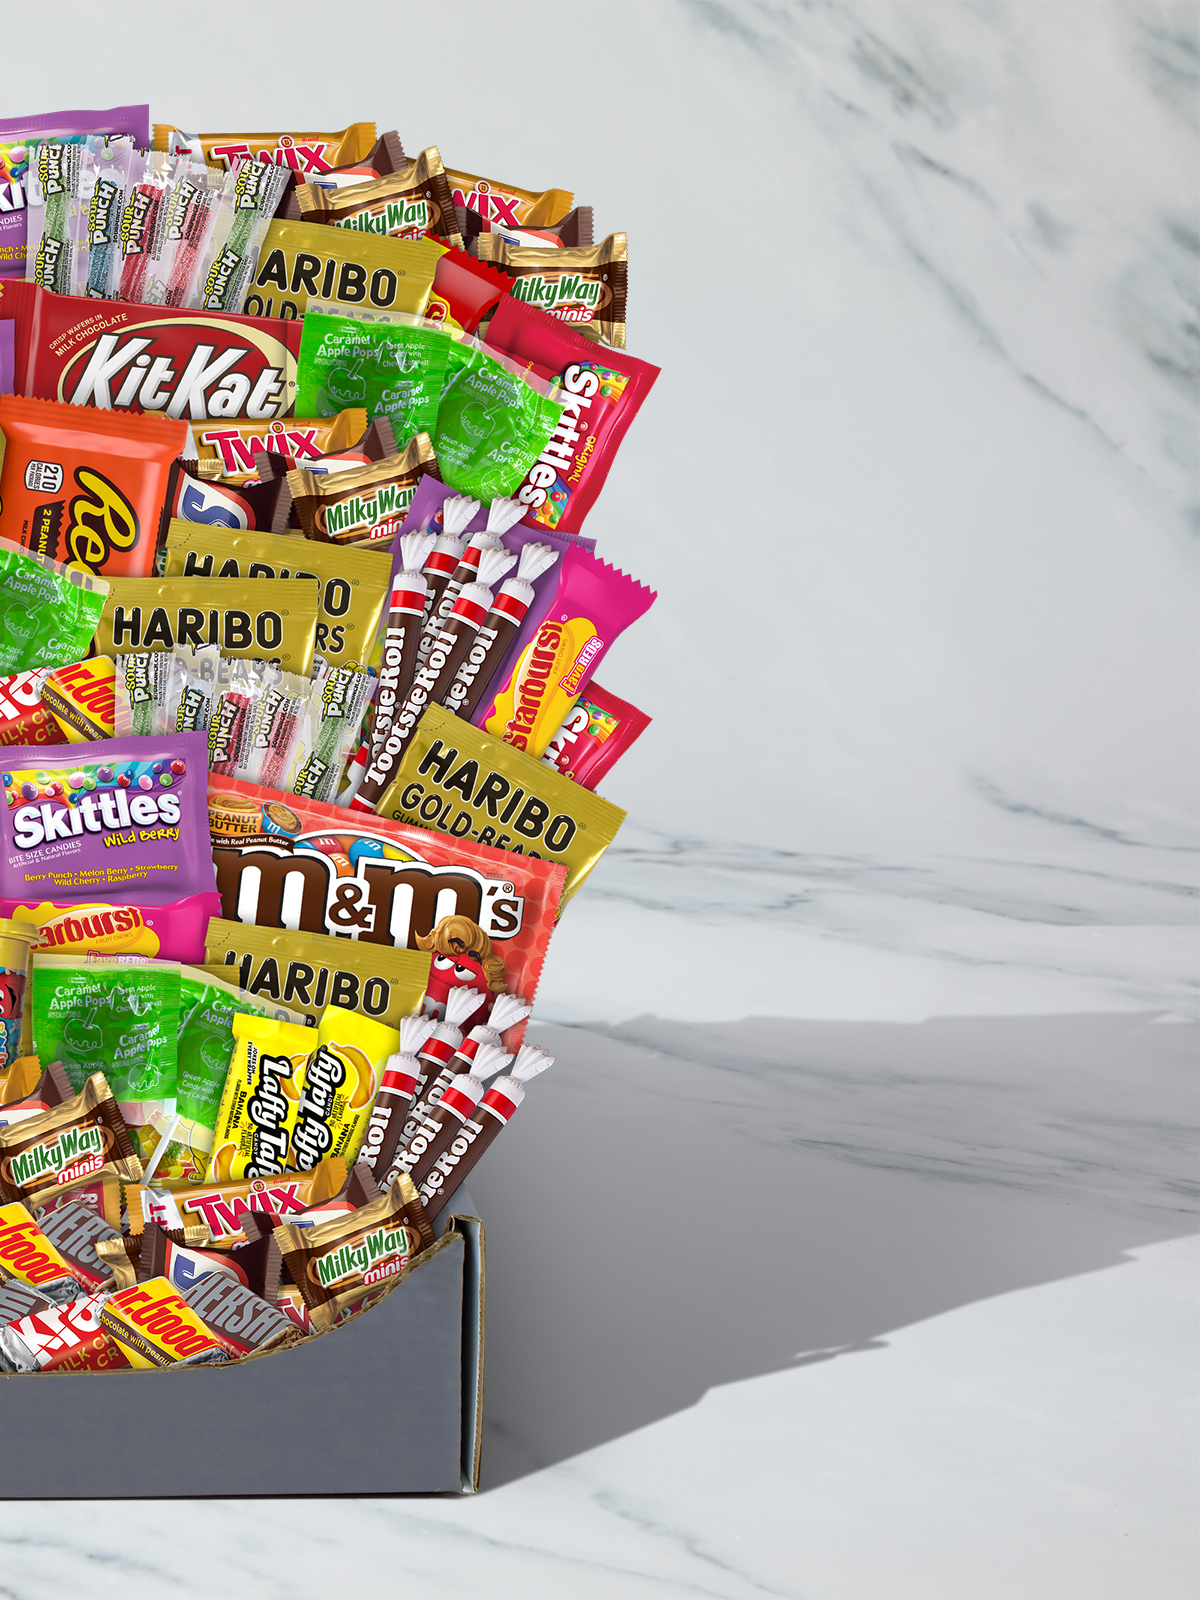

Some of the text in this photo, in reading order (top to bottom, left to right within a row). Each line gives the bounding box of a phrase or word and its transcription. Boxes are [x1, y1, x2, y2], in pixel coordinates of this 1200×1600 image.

[88, 196, 98, 240] SOUR
[93, 180, 118, 245] PUNCH
[122, 203, 134, 242] SOUR
[126, 192, 151, 255] PUNCH
[205, 261, 222, 296] SOUR
[48, 314, 103, 350] CRISP WAFERS IN
[54, 312, 128, 357] MILK CHOCOLATE
[324, 333, 371, 346] Caramel
[317, 343, 380, 358] Apple Pops
[519, 365, 601, 509] Skittles
[42, 465, 60, 492] 210
[36, 518, 52, 564] PEANUT
[112, 606, 283, 650] HARIBO
[3, 646, 24, 658] Apple
[501, 622, 563, 753] Starburst
[68, 710, 86, 728] with
[213, 700, 238, 764] PUNCH
[418, 740, 577, 852] HARIBO
[13, 789, 181, 849] Skittles
[208, 810, 258, 824] PEANUT
[208, 818, 257, 834] BUTTER
[8, 840, 82, 865] BITE SIZE CANDIES
[41, 852, 62, 863] Natural
[62, 848, 82, 859] Flavors
[214, 836, 289, 847] with Real Peanut Butter
[24, 863, 179, 882] Berry Punch Melon Berry Strawberry
[54, 870, 148, 886] Wild Cherry Raspberry
[50, 995, 112, 1010] Apple Pops
[55, 984, 101, 998] Caramel
[248, 1055, 294, 1135] Laffy
[298, 1048, 346, 1120] Taffy
[231, 1091, 247, 1130] BANANA
[324, 1094, 333, 1118] CANDY
[252, 1132, 260, 1156] CANDY
[330, 1122, 351, 1160] BANANA
[57, 1154, 104, 1184] minis
[362, 1255, 410, 1286] minis
